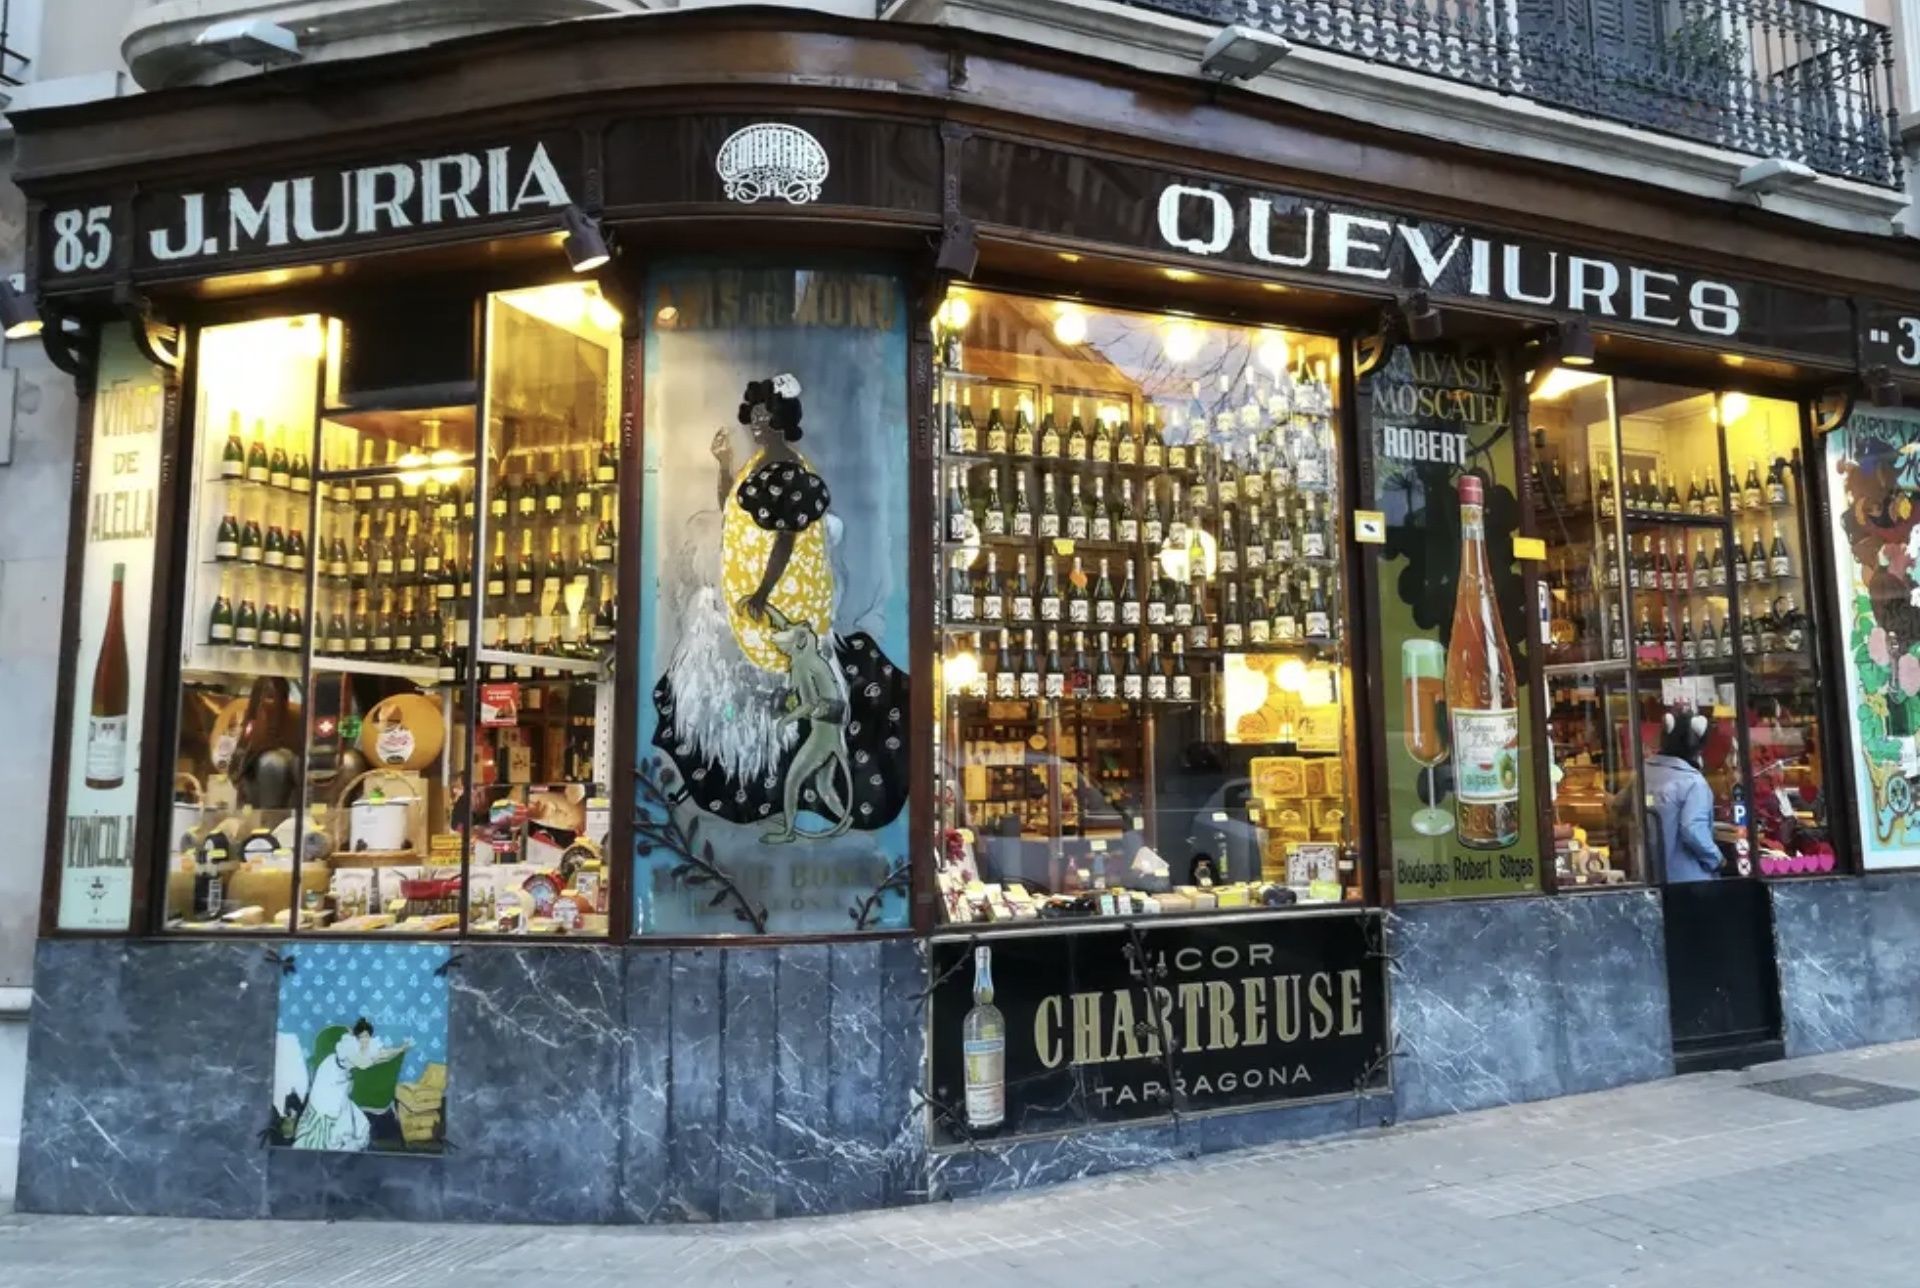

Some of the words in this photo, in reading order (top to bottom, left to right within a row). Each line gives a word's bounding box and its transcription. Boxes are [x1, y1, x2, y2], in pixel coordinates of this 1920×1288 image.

[53, 205, 111, 272] 85
[1158, 184, 1740, 336] QUEVIURES
[1371, 383, 1510, 425] MOSCATEL
[112, 451, 140, 475] DE
[1383, 425, 1468, 465] ROBERT
[91, 489, 153, 542] ALELLA
[1734, 805, 1747, 824] P
[1398, 858, 1450, 888] Bodegas
[1453, 856, 1493, 880] Robert
[1130, 944, 1274, 975] LICOR
[1034, 970, 1363, 1069] CHARTREUSE
[1096, 1064, 1312, 1107] TARRAGONA
